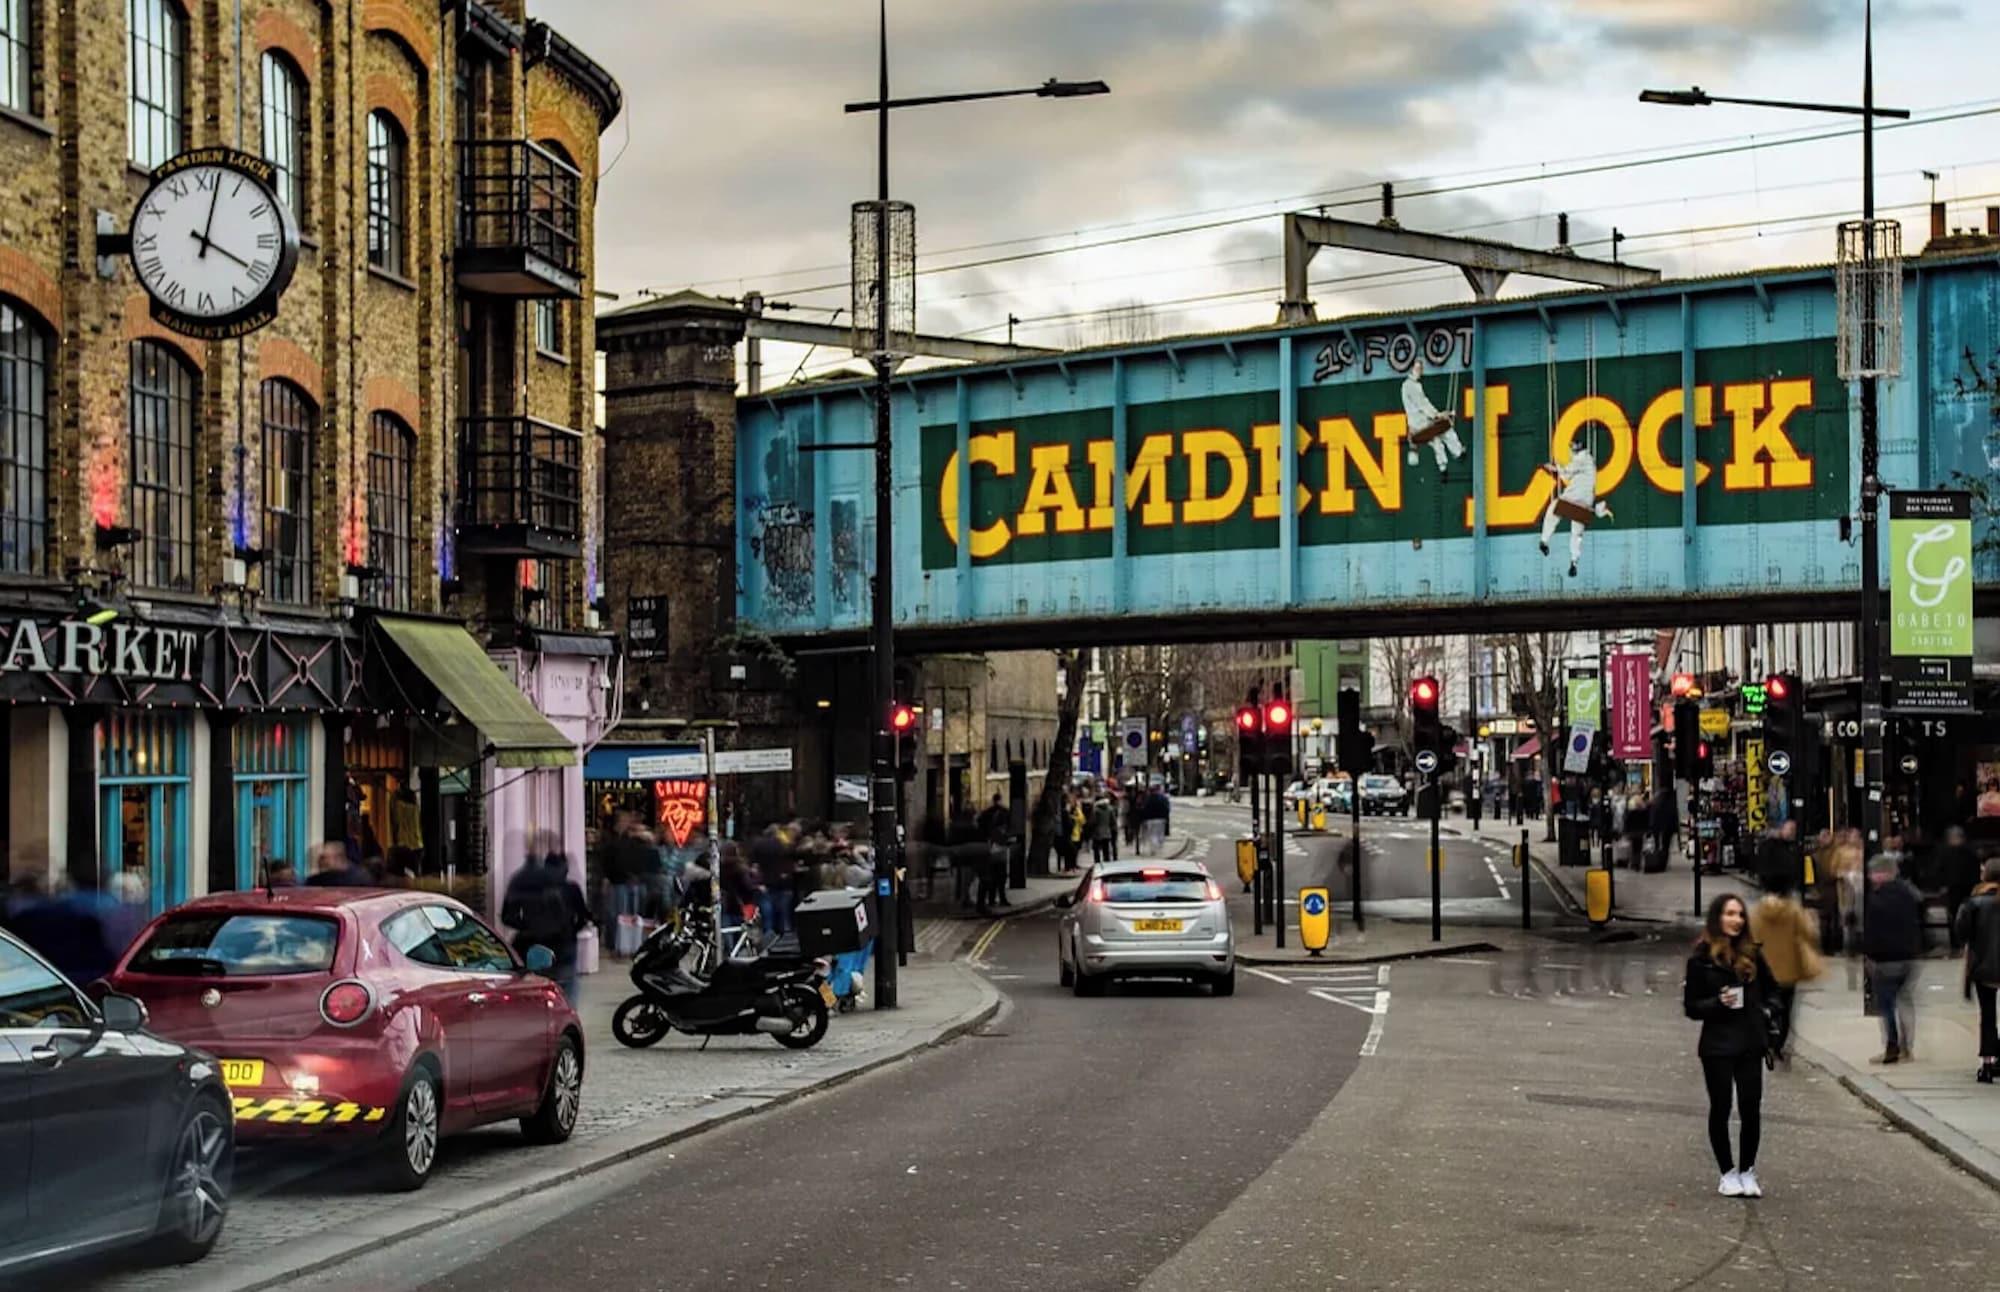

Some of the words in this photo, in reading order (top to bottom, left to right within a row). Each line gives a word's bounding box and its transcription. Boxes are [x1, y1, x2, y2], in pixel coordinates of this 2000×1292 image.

[156, 150, 224, 179] CAMDEN
[228, 151, 272, 180] LOCK
[158, 310, 225, 338] MARKET
[229, 311, 272, 337] HALL
[1362, 326, 1474, 375] FOOT
[940, 412, 1408, 558] CAMDEN
[1464, 378, 1813, 529] LOCK
[1897, 612, 1966, 629] GABETO
[1, 619, 197, 681] ARKET
[655, 780, 707, 797] CAMDEN
